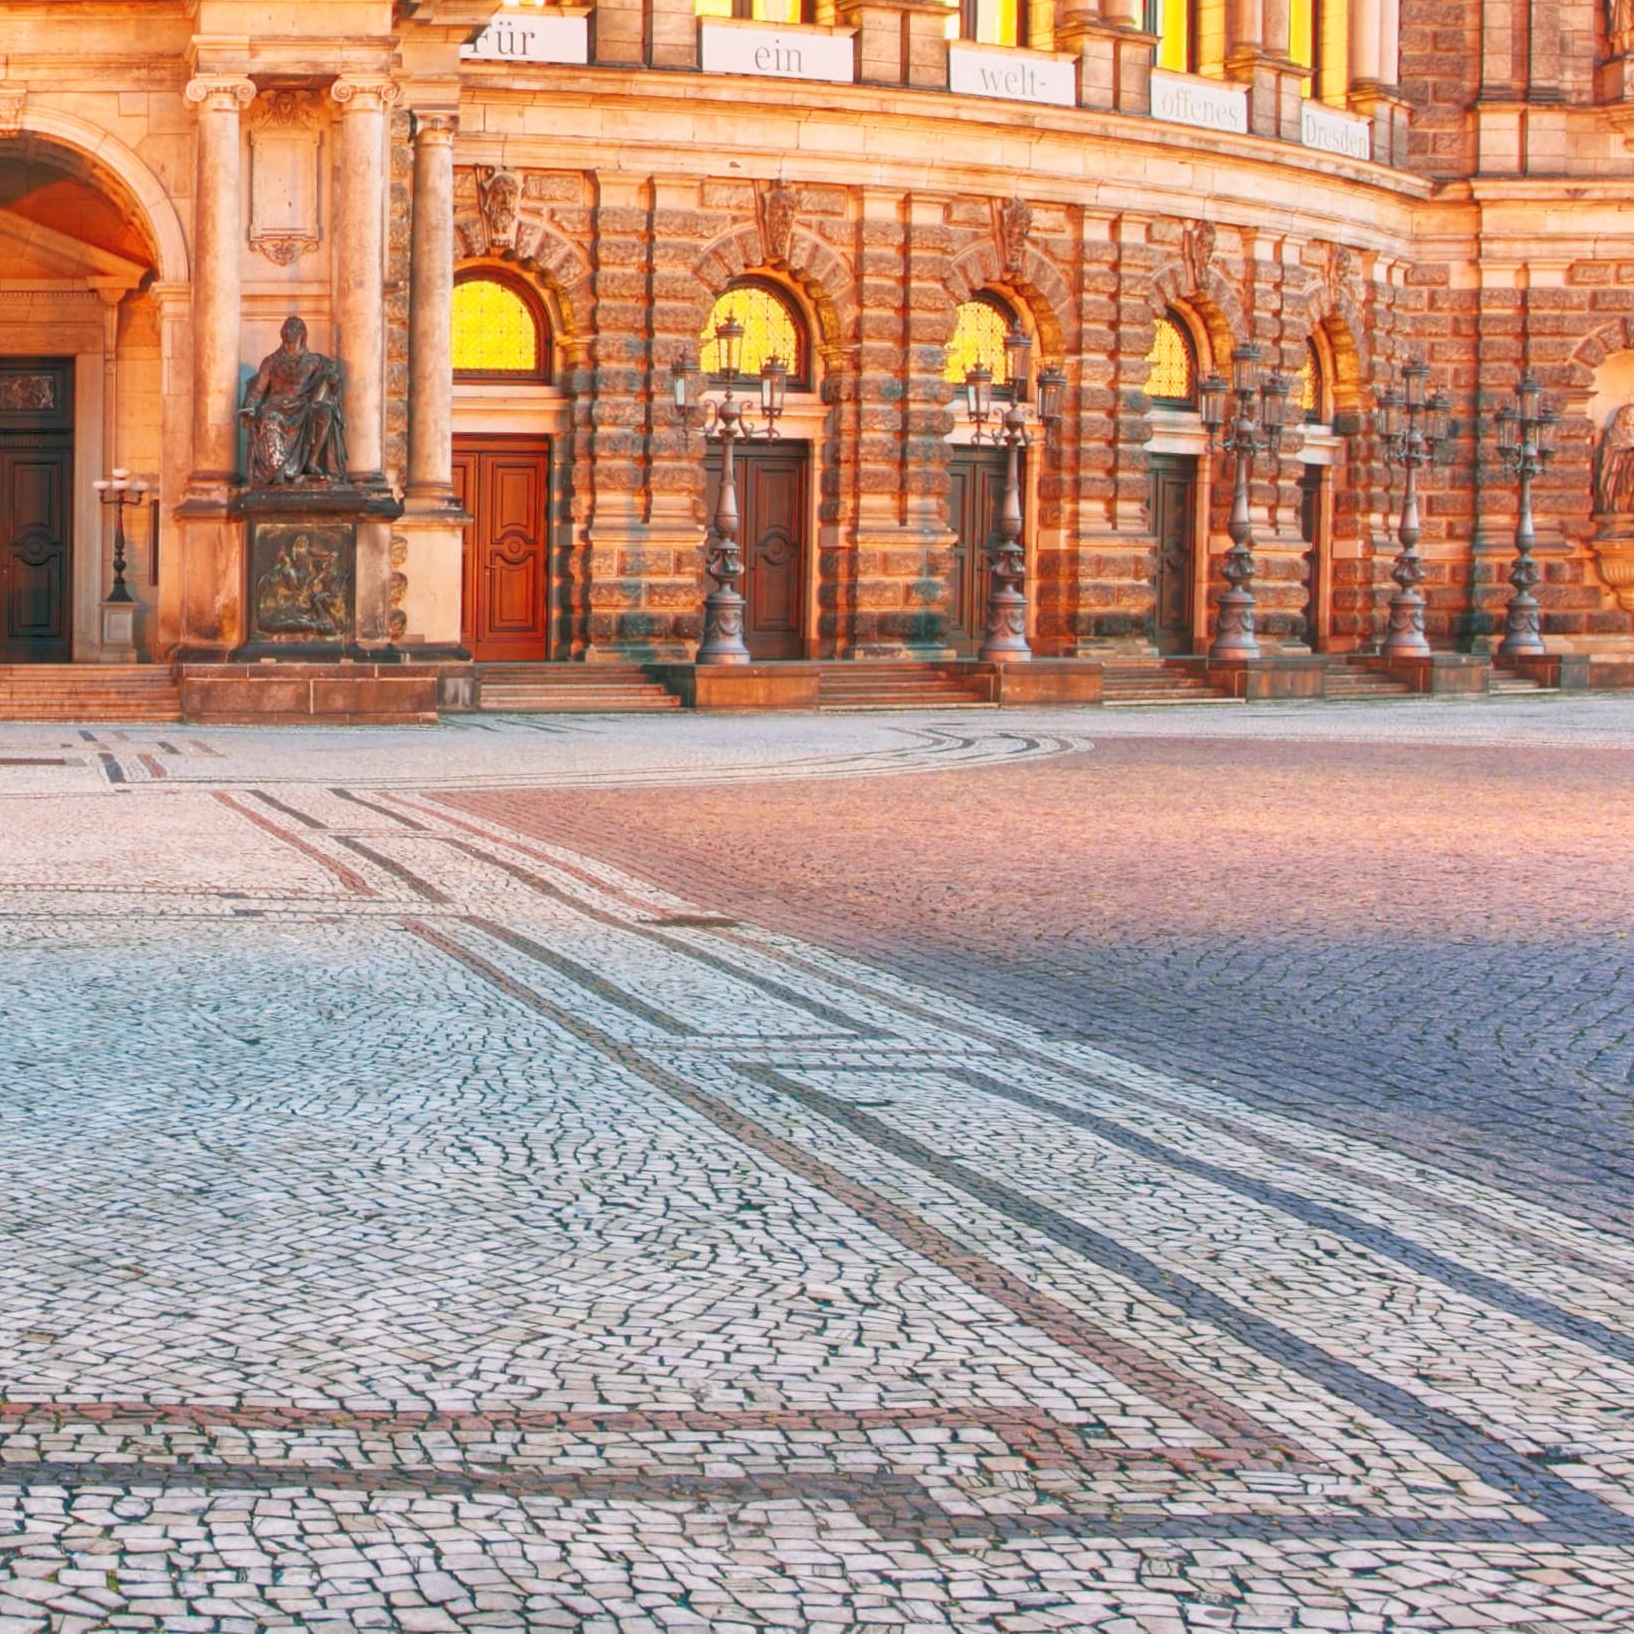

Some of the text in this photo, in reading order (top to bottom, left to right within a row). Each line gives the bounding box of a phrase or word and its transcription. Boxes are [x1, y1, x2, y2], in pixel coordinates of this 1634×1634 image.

[754, 39, 806, 74] ein
[979, 64, 1047, 97] welt-
[1161, 87, 1238, 126] offenes
[1306, 114, 1368, 159] Dresden
